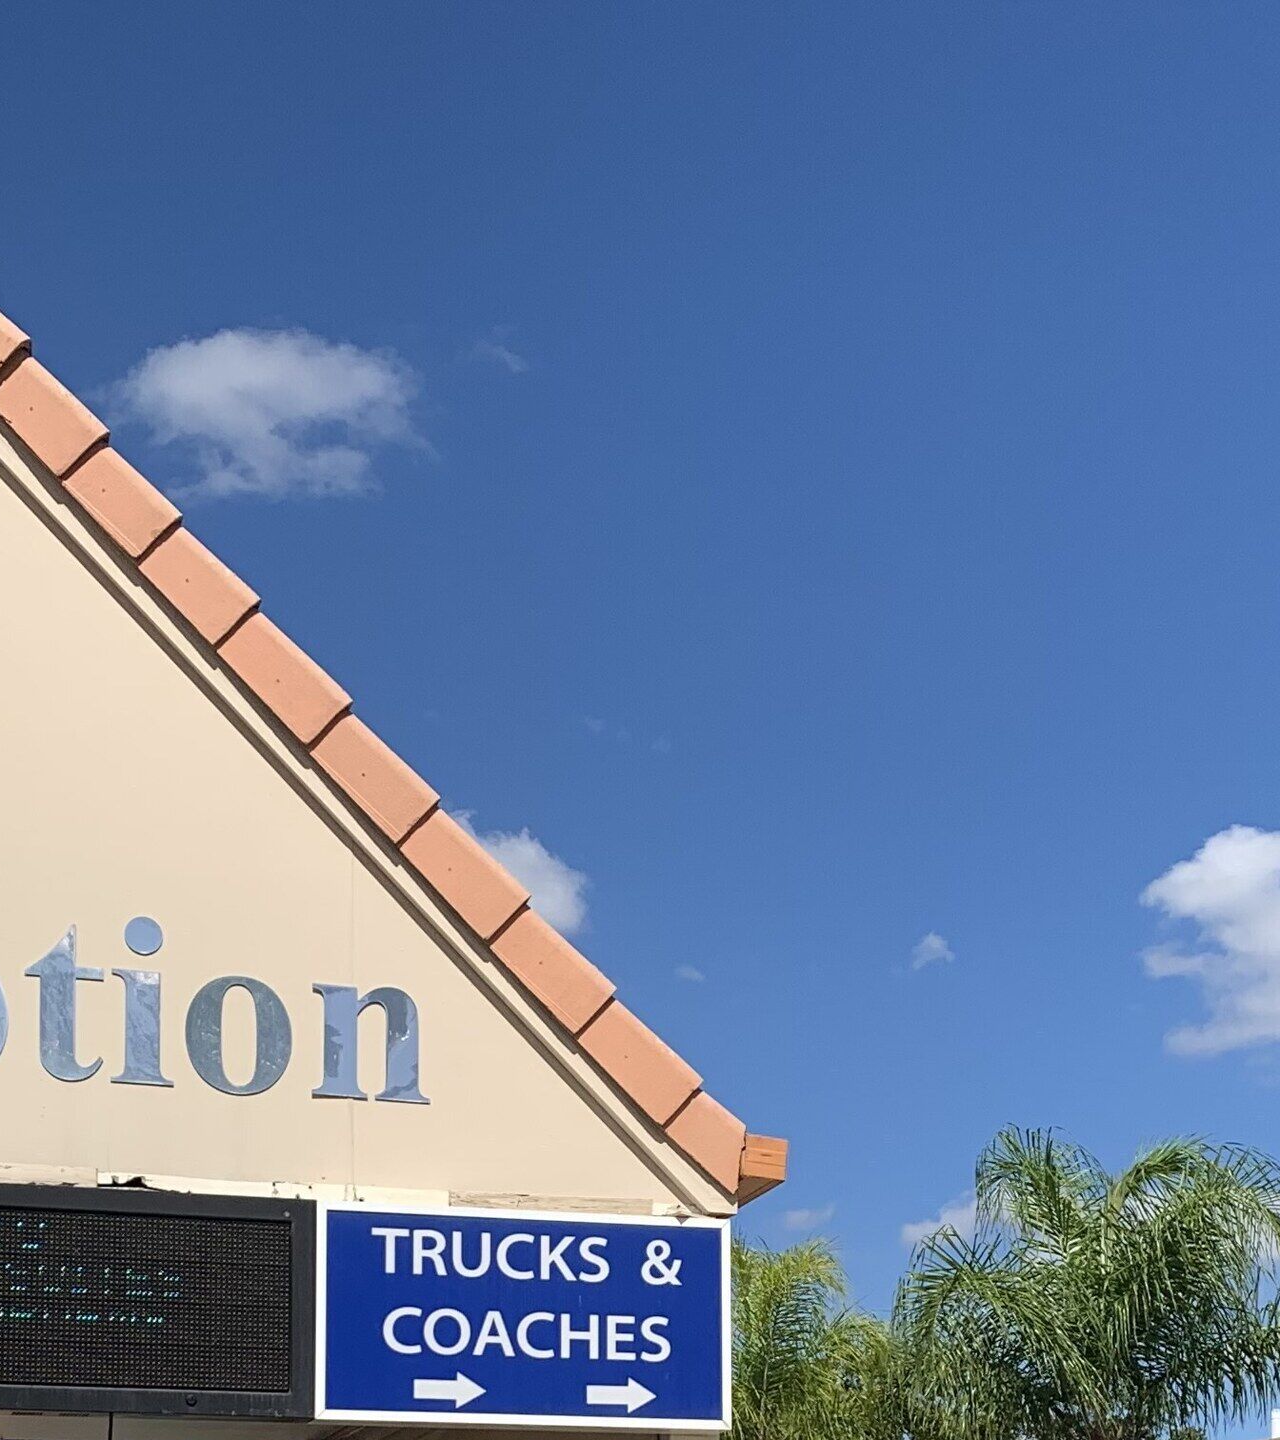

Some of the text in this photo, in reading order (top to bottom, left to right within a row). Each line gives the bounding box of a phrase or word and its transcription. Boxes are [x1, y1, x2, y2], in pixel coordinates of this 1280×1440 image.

[371, 1227, 682, 1286] TRUCKS &
[382, 1306, 671, 1363] COACHES
